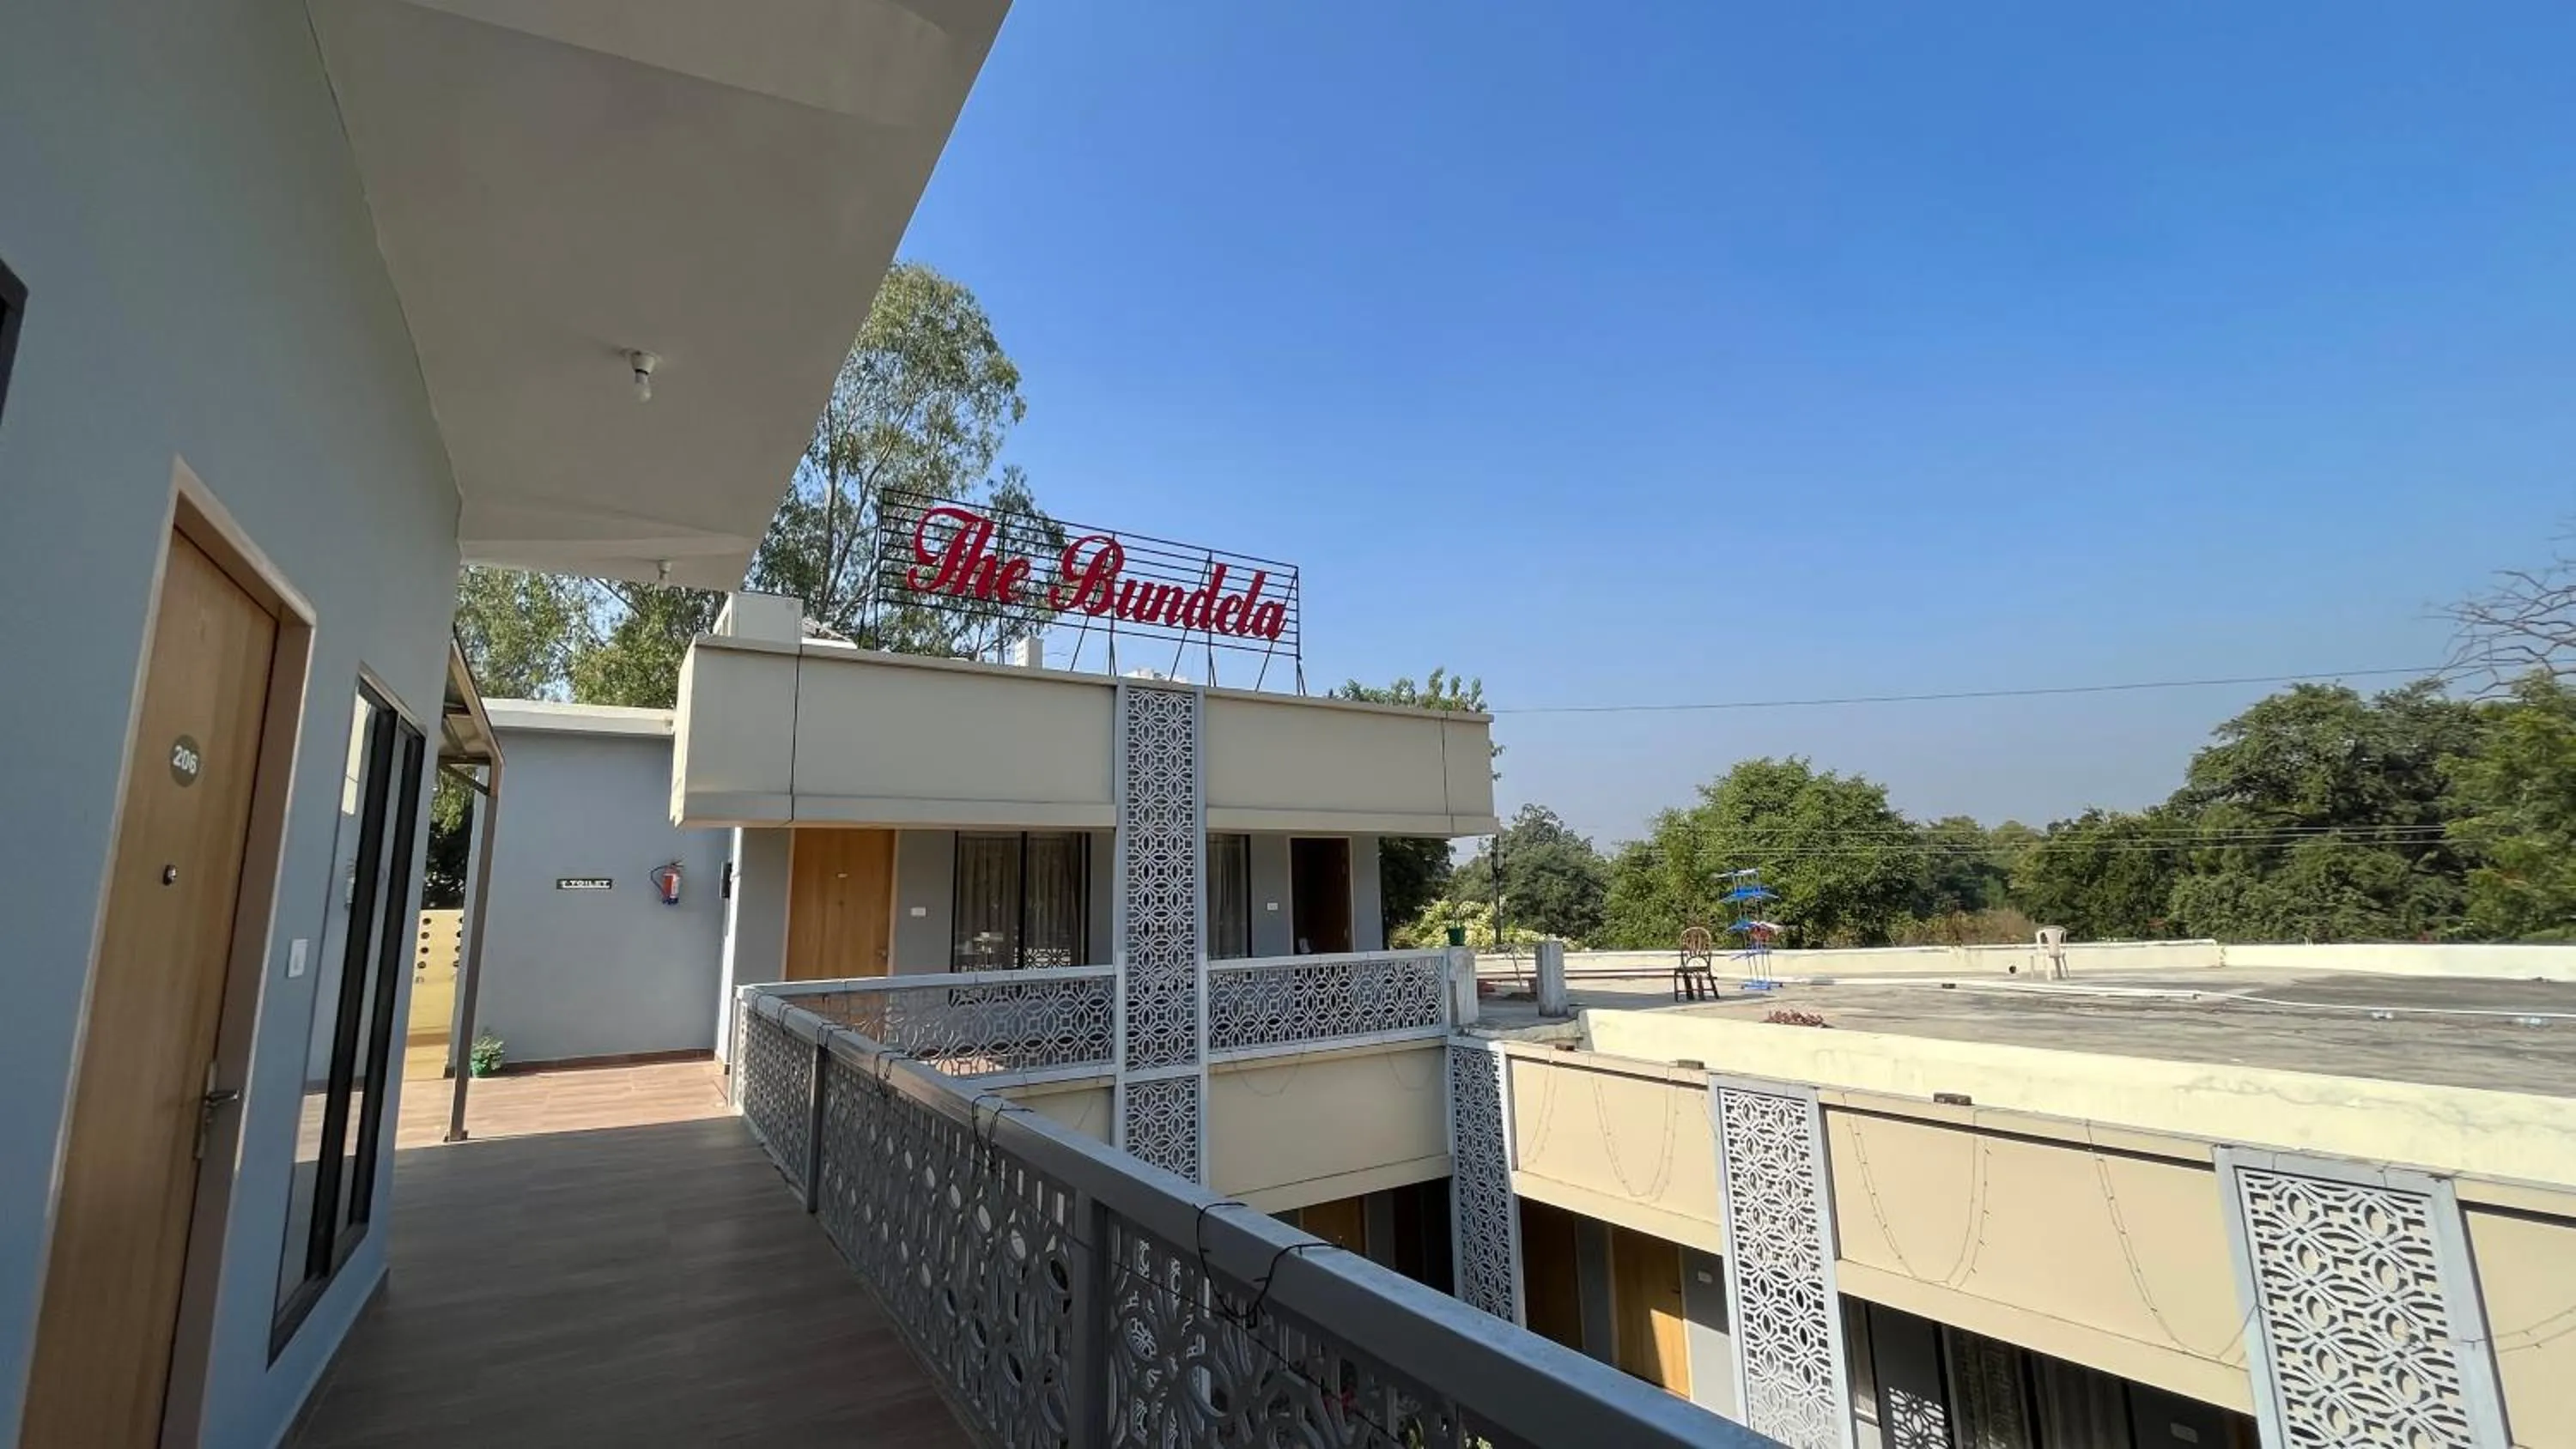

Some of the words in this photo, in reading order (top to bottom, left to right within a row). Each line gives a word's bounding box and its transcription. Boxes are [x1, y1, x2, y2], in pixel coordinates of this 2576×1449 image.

[907, 507, 1029, 603] The
[1048, 535, 1287, 640] Bundela
[173, 745, 198, 774] 206
[570, 880, 611, 889] TOILET
